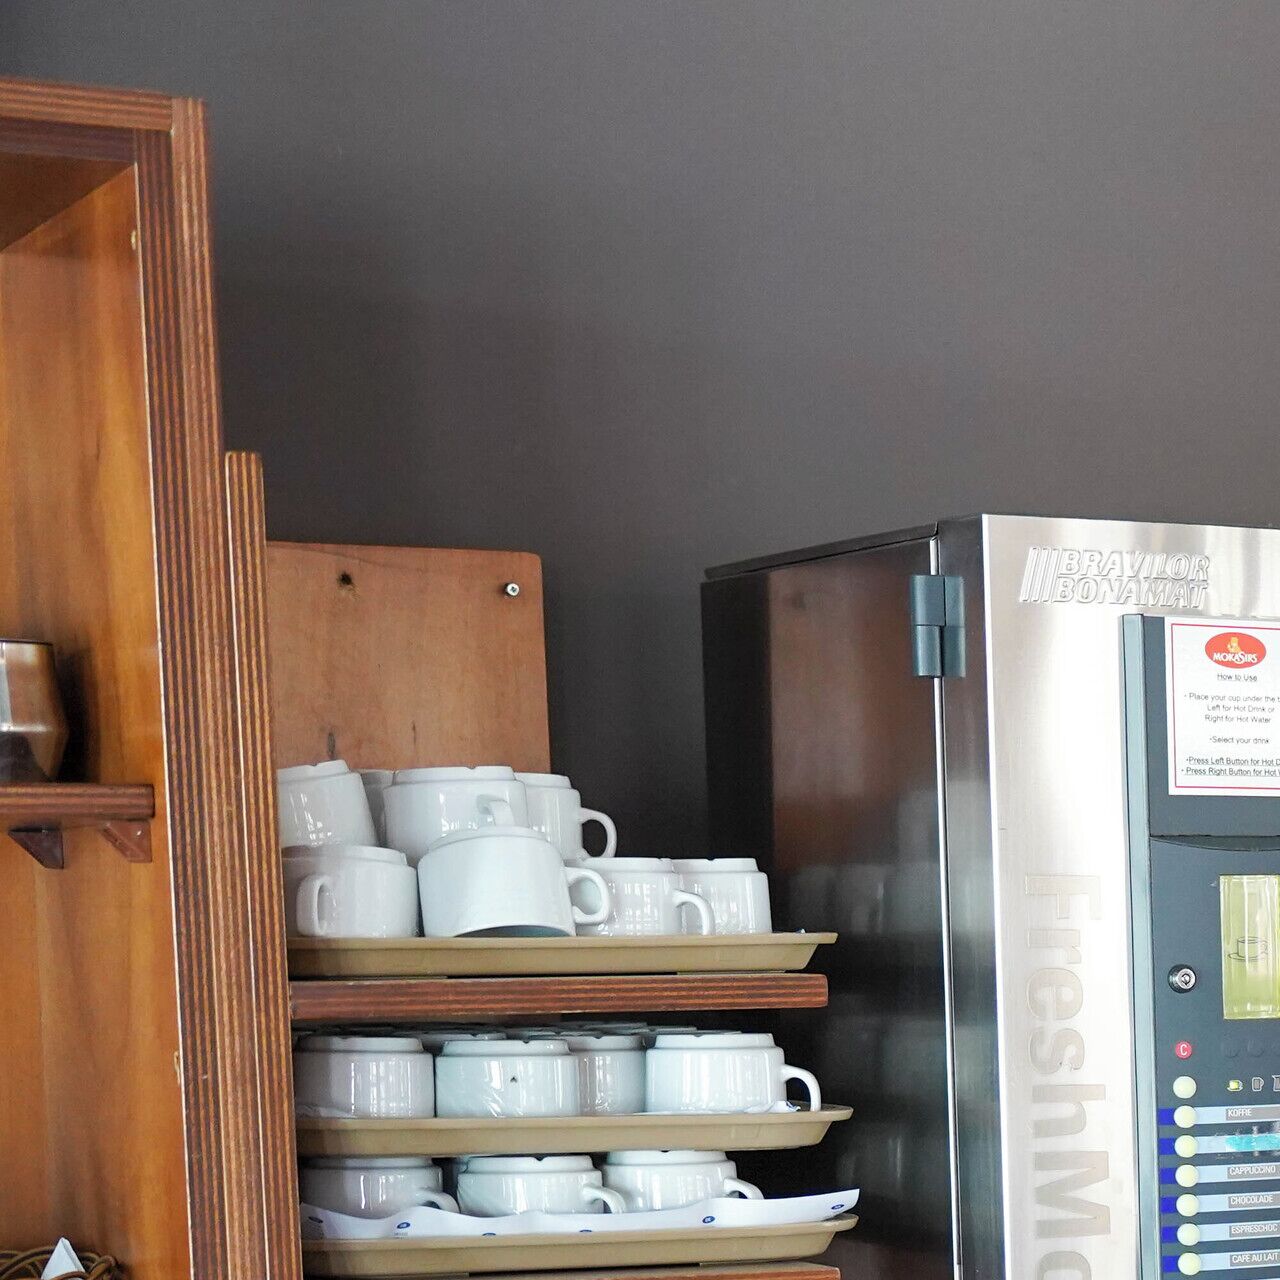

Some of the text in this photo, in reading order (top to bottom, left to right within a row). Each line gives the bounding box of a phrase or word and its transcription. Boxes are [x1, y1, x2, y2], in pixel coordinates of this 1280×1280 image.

[1058, 549, 1210, 582] BRAVILOR
[1052, 576, 1208, 609] BONAMAT
[1217, 673, 1233, 681] How
[1244, 674, 1258, 682] Use
[1189, 692, 1209, 700] Place
[1211, 694, 1226, 703] your
[1228, 696, 1241, 704] cup
[1207, 704, 1221, 712] Left
[1222, 704, 1232, 712] for
[1248, 705, 1265, 713] Drink
[1204, 714, 1224, 723] Right
[1236, 714, 1249, 722] Hot
[1251, 715, 1272, 723] Water
[1236, 737, 1251, 745] your
[1211, 757, 1225, 765] Left
[1226, 757, 1248, 765] Button
[1250, 757, 1260, 765] for
[1262, 758, 1274, 766] Hot
[1186, 767, 1207, 775] Press
[1208, 767, 1227, 776] Right
[1229, 767, 1251, 775] Button
[1228, 1108, 1252, 1117] KOFFIE
[1229, 1166, 1276, 1176] CAPPUCCINO
[1230, 1195, 1274, 1205] CHOCOLADE
[1231, 1223, 1278, 1234] ESPRESCHOC
[1252, 1254, 1262, 1262] AU
[1263, 1252, 1279, 1261] LAIT
